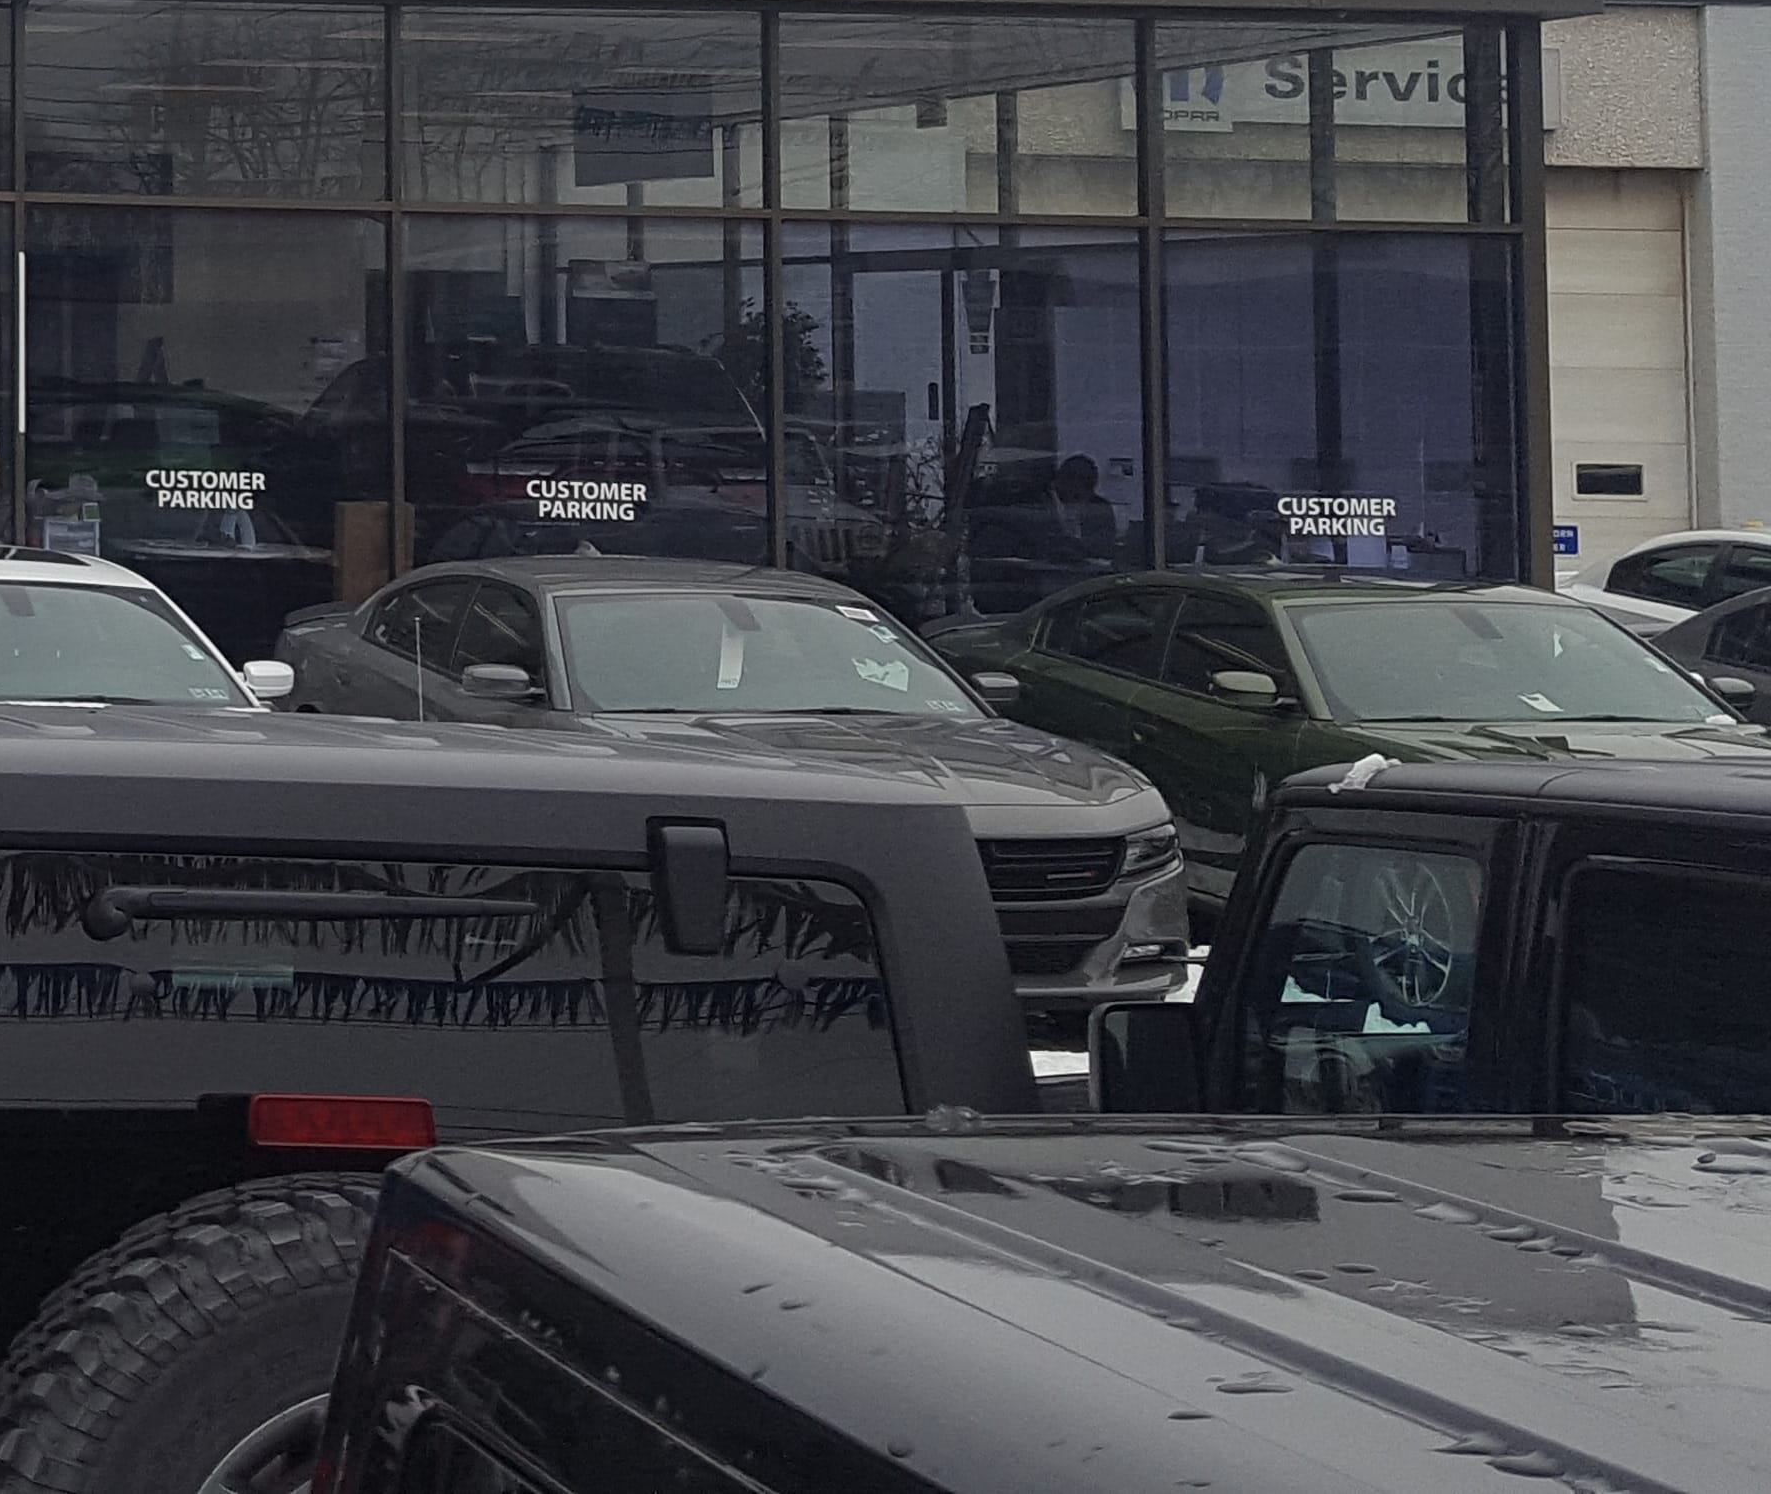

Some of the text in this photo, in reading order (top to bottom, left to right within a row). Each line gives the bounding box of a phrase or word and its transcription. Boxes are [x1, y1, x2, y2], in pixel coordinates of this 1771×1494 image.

[145, 469, 266, 491] CUSTOMER
[158, 490, 254, 510] PARKING
[525, 479, 648, 502] CUSTOMER
[539, 500, 636, 521] PARKING
[1277, 497, 1397, 517] CUSTOMER
[1290, 517, 1386, 536] PARKING
